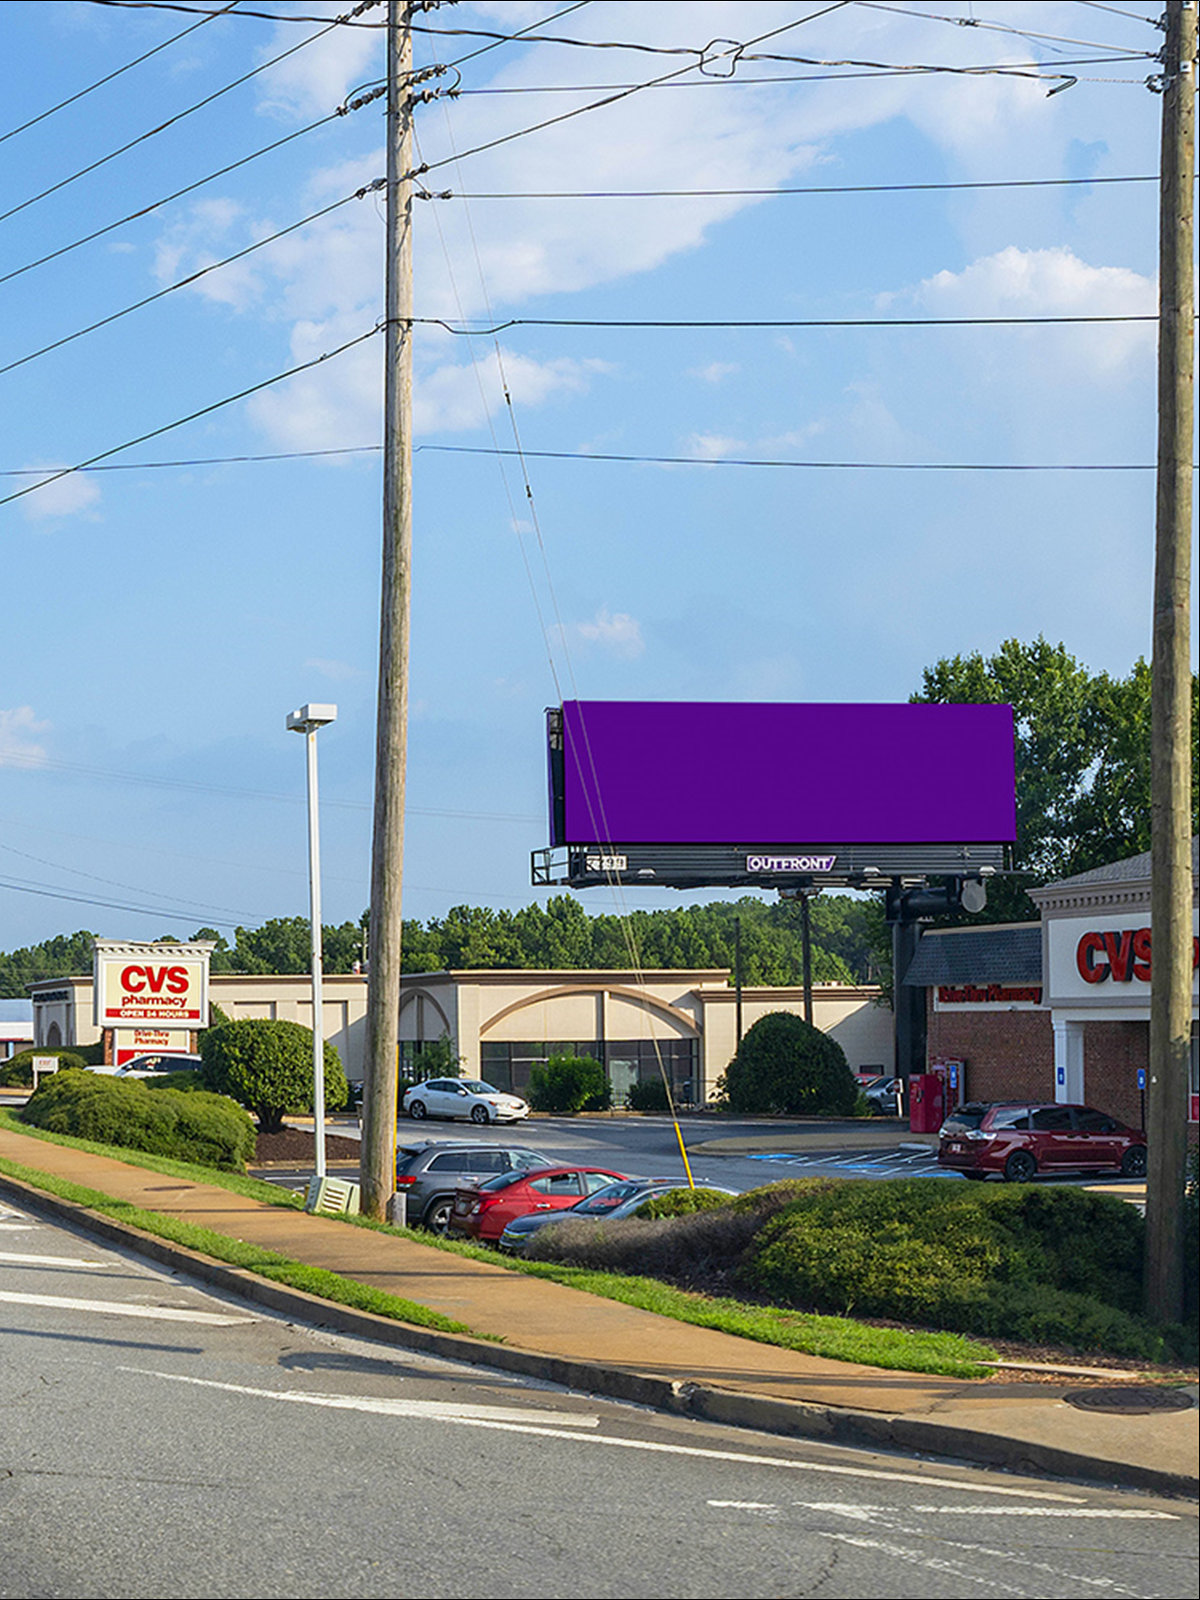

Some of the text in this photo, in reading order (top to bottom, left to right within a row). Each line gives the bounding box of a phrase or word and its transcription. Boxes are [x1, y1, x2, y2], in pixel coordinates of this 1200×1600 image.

[750, 857, 831, 870] OUTFRONT
[1076, 927, 1152, 984] CVS
[120, 965, 189, 994] CVS
[121, 994, 188, 1008] pharmacy
[119, 1009, 144, 1017] OPEN
[158, 1010, 189, 1018] HOURS
[134, 1037, 169, 1047] Pharmacy
